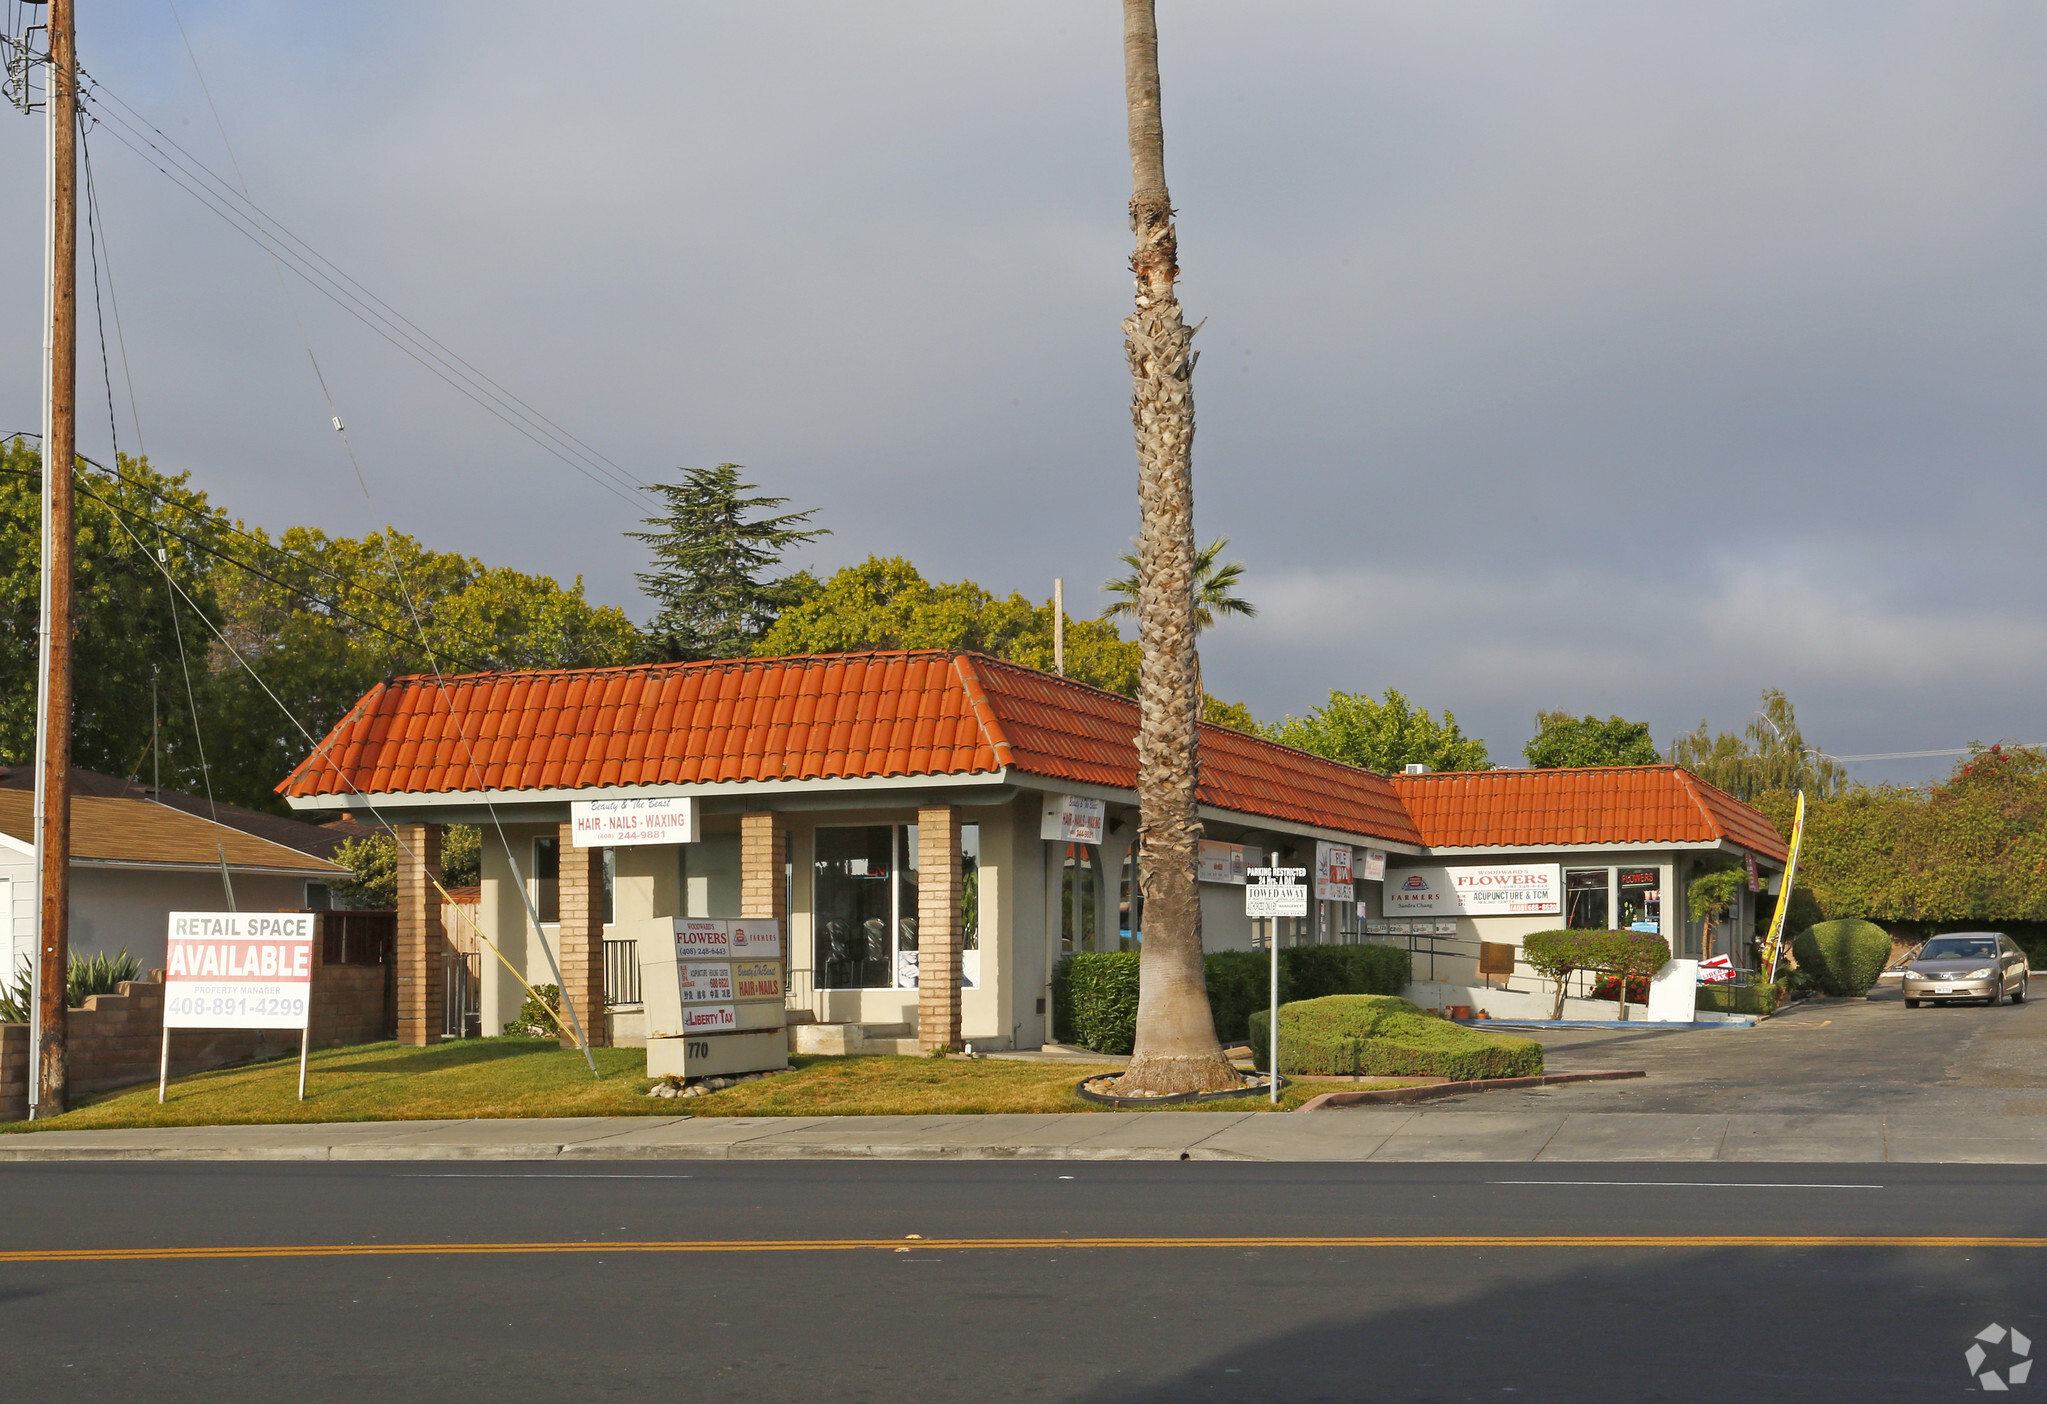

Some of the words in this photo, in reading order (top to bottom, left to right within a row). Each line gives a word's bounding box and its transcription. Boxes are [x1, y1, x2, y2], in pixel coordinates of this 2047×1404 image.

[590, 800, 618, 812] Beauty
[621, 800, 627, 809] &
[630, 798, 644, 809] The
[648, 797, 671, 808] Beast
[578, 818, 601, 831] HAIR
[609, 815, 637, 830] NAILS
[646, 813, 685, 828] WAXING
[618, 830, 666, 840] 244-9881
[1247, 868, 1272, 876] PARKING
[1272, 868, 1306, 876] RESTRICTED
[1622, 873, 1654, 883] FLOWERS
[1258, 876, 1266, 884] 24
[1284, 876, 1296, 884] DAY
[1458, 874, 1548, 886] FLOWERS
[1249, 889, 1279, 898] TOWED
[1282, 889, 1304, 898] AWAY
[1473, 891, 1523, 900] ACUPUNCTURE
[1533, 891, 1548, 899] TCM
[176, 918, 240, 936] RETAIL
[247, 919, 307, 936] SPACE
[676, 932, 727, 944] FLOWERS
[679, 947, 696, 956] (408)
[698, 947, 726, 956] 248-6443
[168, 945, 309, 976] AVAILABLE
[1713, 973, 1728, 982] TAX
[194, 986, 238, 994] PROPERTY
[240, 987, 280, 995] MANAGER
[738, 981, 755, 996] HAIR
[758, 979, 778, 995] NAILS
[168, 998, 304, 1016] 408-891-4299
[689, 1011, 718, 1026] LIBERTY
[688, 1042, 708, 1058] 770
